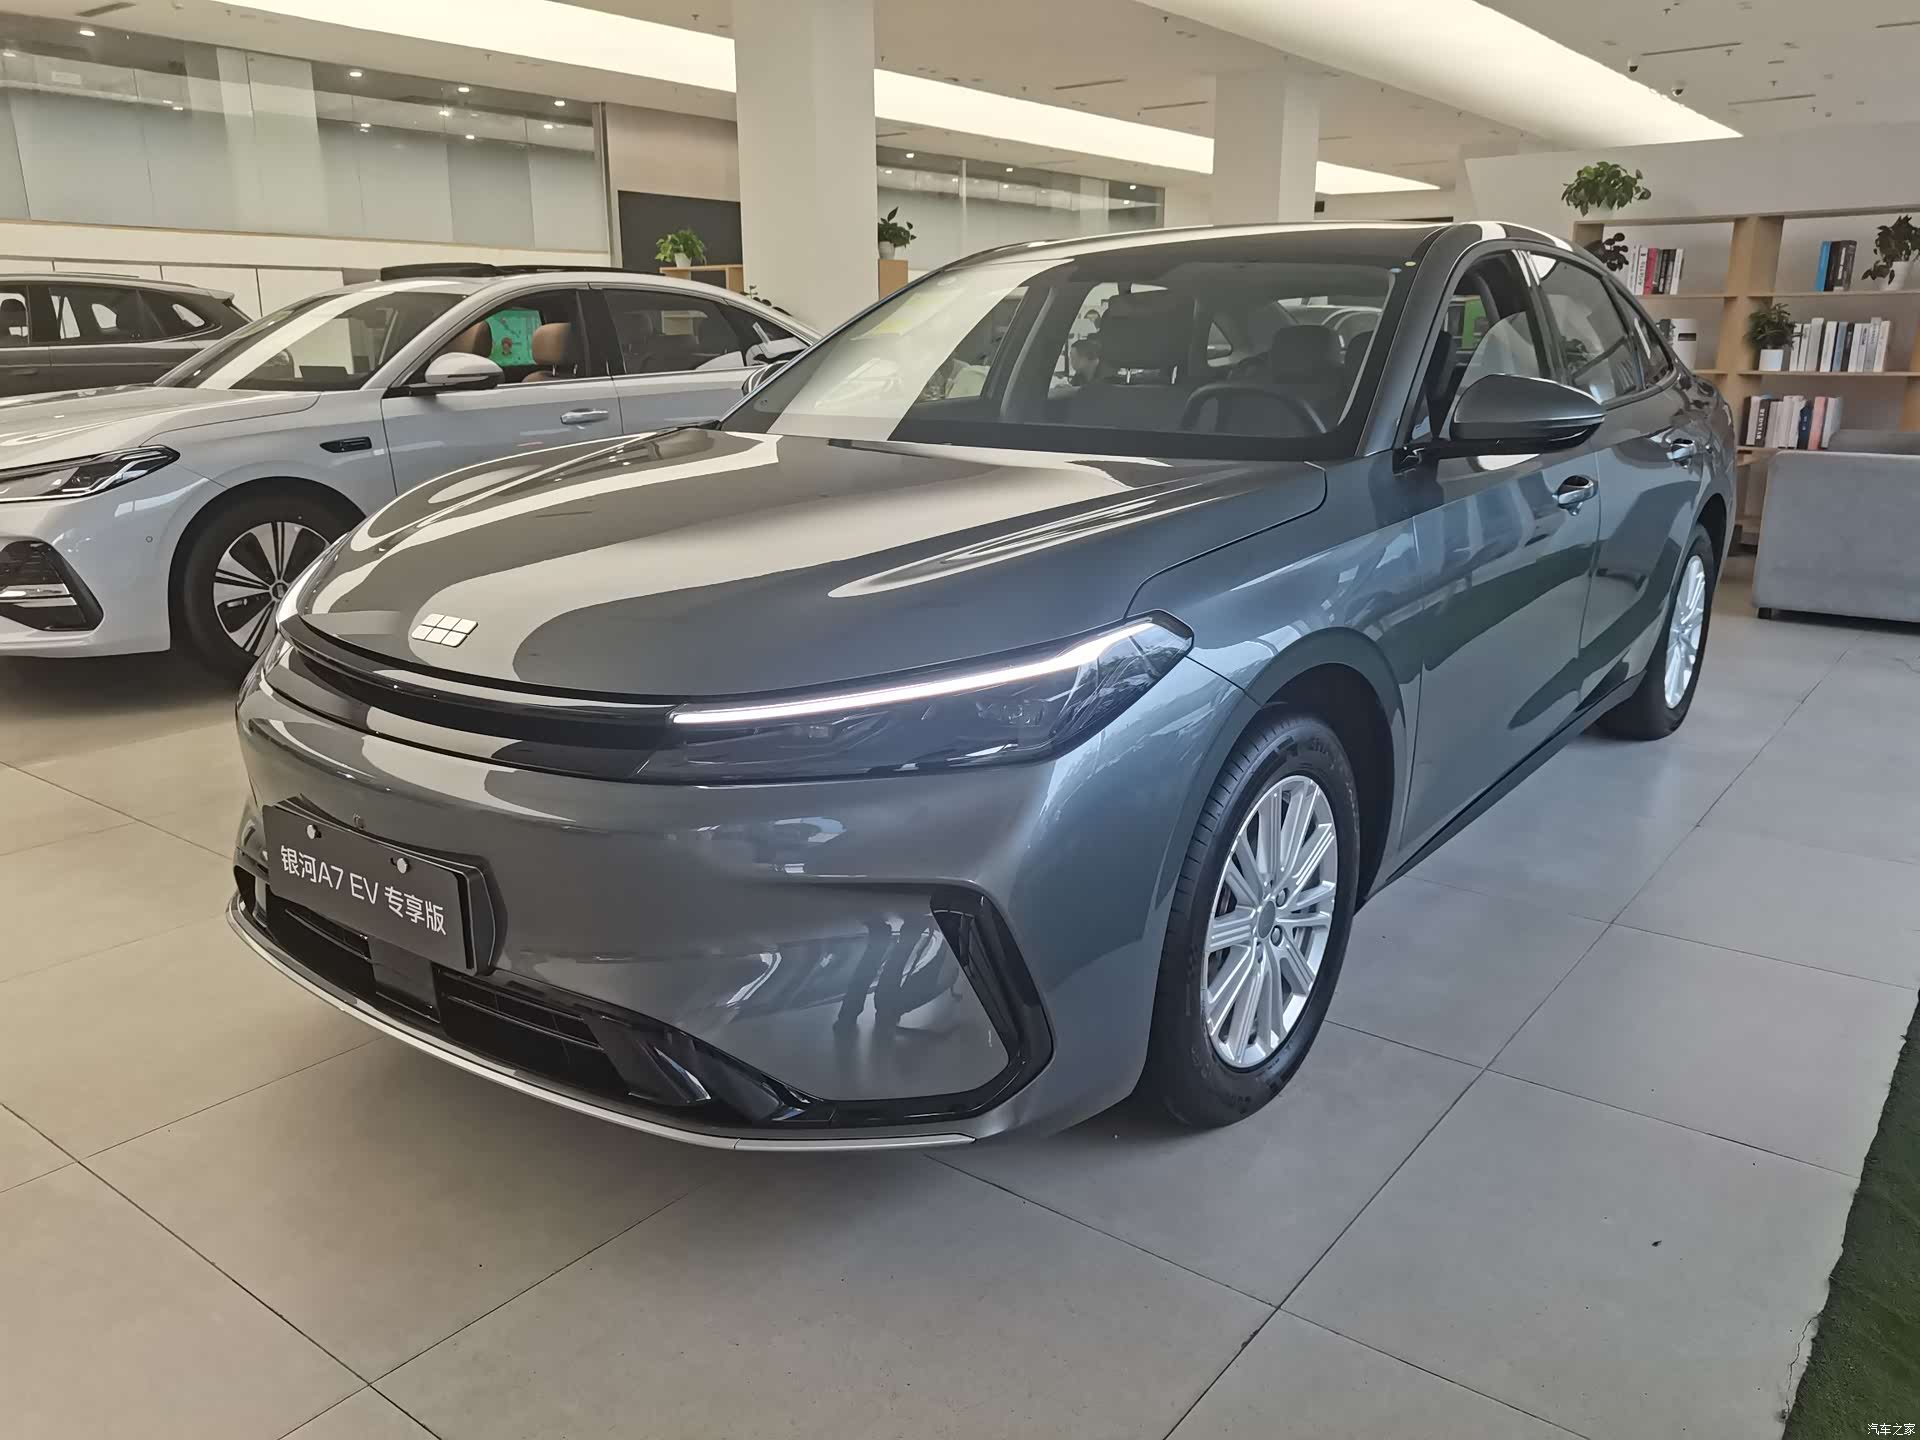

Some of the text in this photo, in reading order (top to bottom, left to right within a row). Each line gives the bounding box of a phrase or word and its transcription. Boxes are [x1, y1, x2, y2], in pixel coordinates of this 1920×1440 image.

[280, 845, 447, 936] 银河A7 EV 专享版
